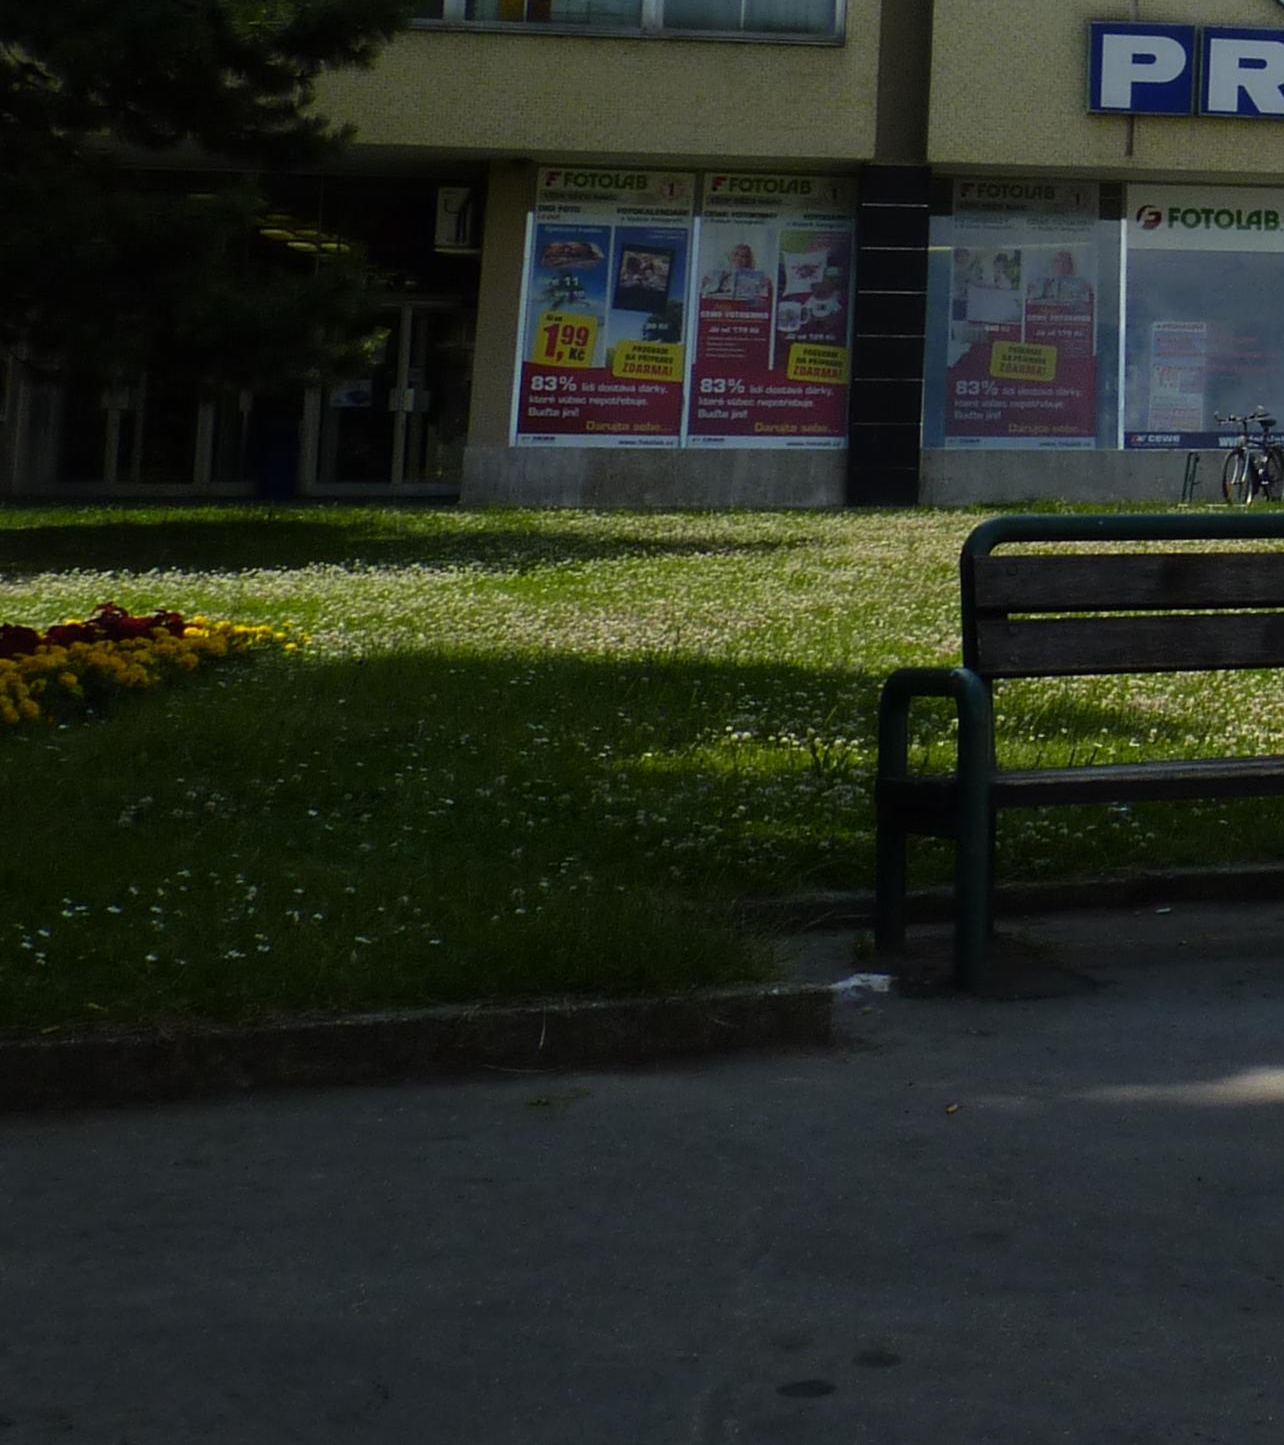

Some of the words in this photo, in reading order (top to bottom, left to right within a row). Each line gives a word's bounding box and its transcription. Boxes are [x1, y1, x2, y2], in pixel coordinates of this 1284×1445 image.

[563, 171, 648, 190] FOTOLAB
[728, 177, 812, 194] FOTOLAB
[976, 183, 1056, 201] FOTOLAB
[544, 323, 590, 362] 1,99
[531, 375, 577, 392] 83%
[700, 378, 746, 394] 83%
[955, 379, 999, 395] 83%
[586, 420, 630, 432] Darujte
[754, 421, 798, 433] Darujte
